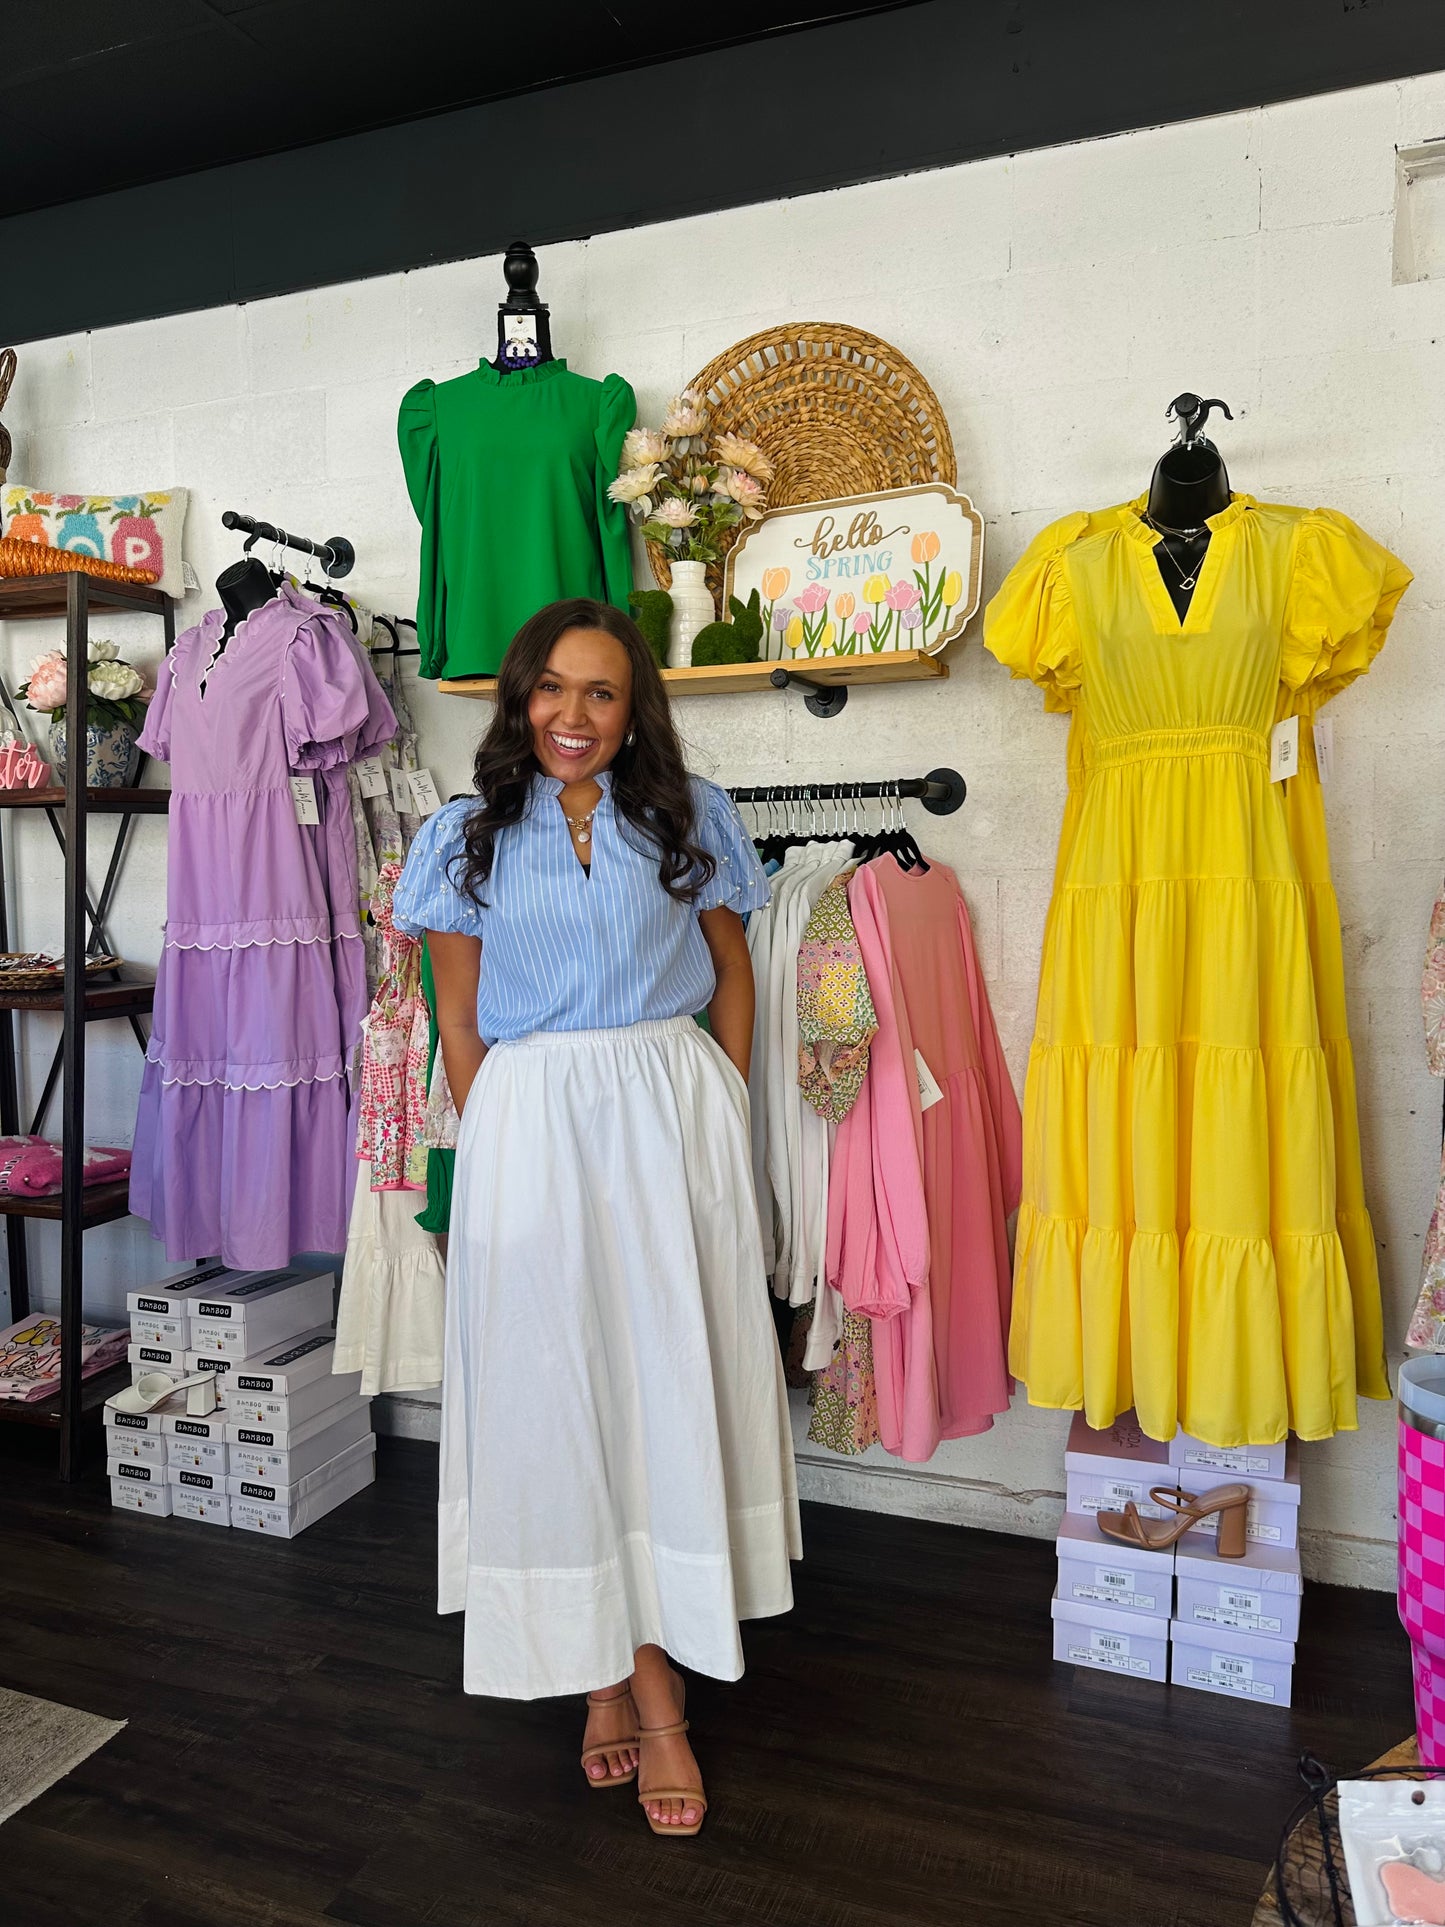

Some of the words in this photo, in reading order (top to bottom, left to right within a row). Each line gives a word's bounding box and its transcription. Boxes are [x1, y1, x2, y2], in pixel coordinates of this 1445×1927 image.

[794, 510, 911, 559] hello
[805, 550, 893, 581] SPRING
[139, 1301, 167, 1311] BAMBOO
[200, 1305, 230, 1315] BAMBOO
[141, 1350, 170, 1361] BAMBOO
[199, 1361, 230, 1371] BAMBOO
[240, 1379, 271, 1389] BAMBOO
[116, 1416, 146, 1426] BAMBOO
[177, 1423, 208, 1434] BAMBOO
[240, 1432, 271, 1443] BAMBOO
[120, 1466, 149, 1478] BAMBOO
[181, 1474, 211, 1486] BAMBOO
[242, 1485, 273, 1498] BAMBOO
